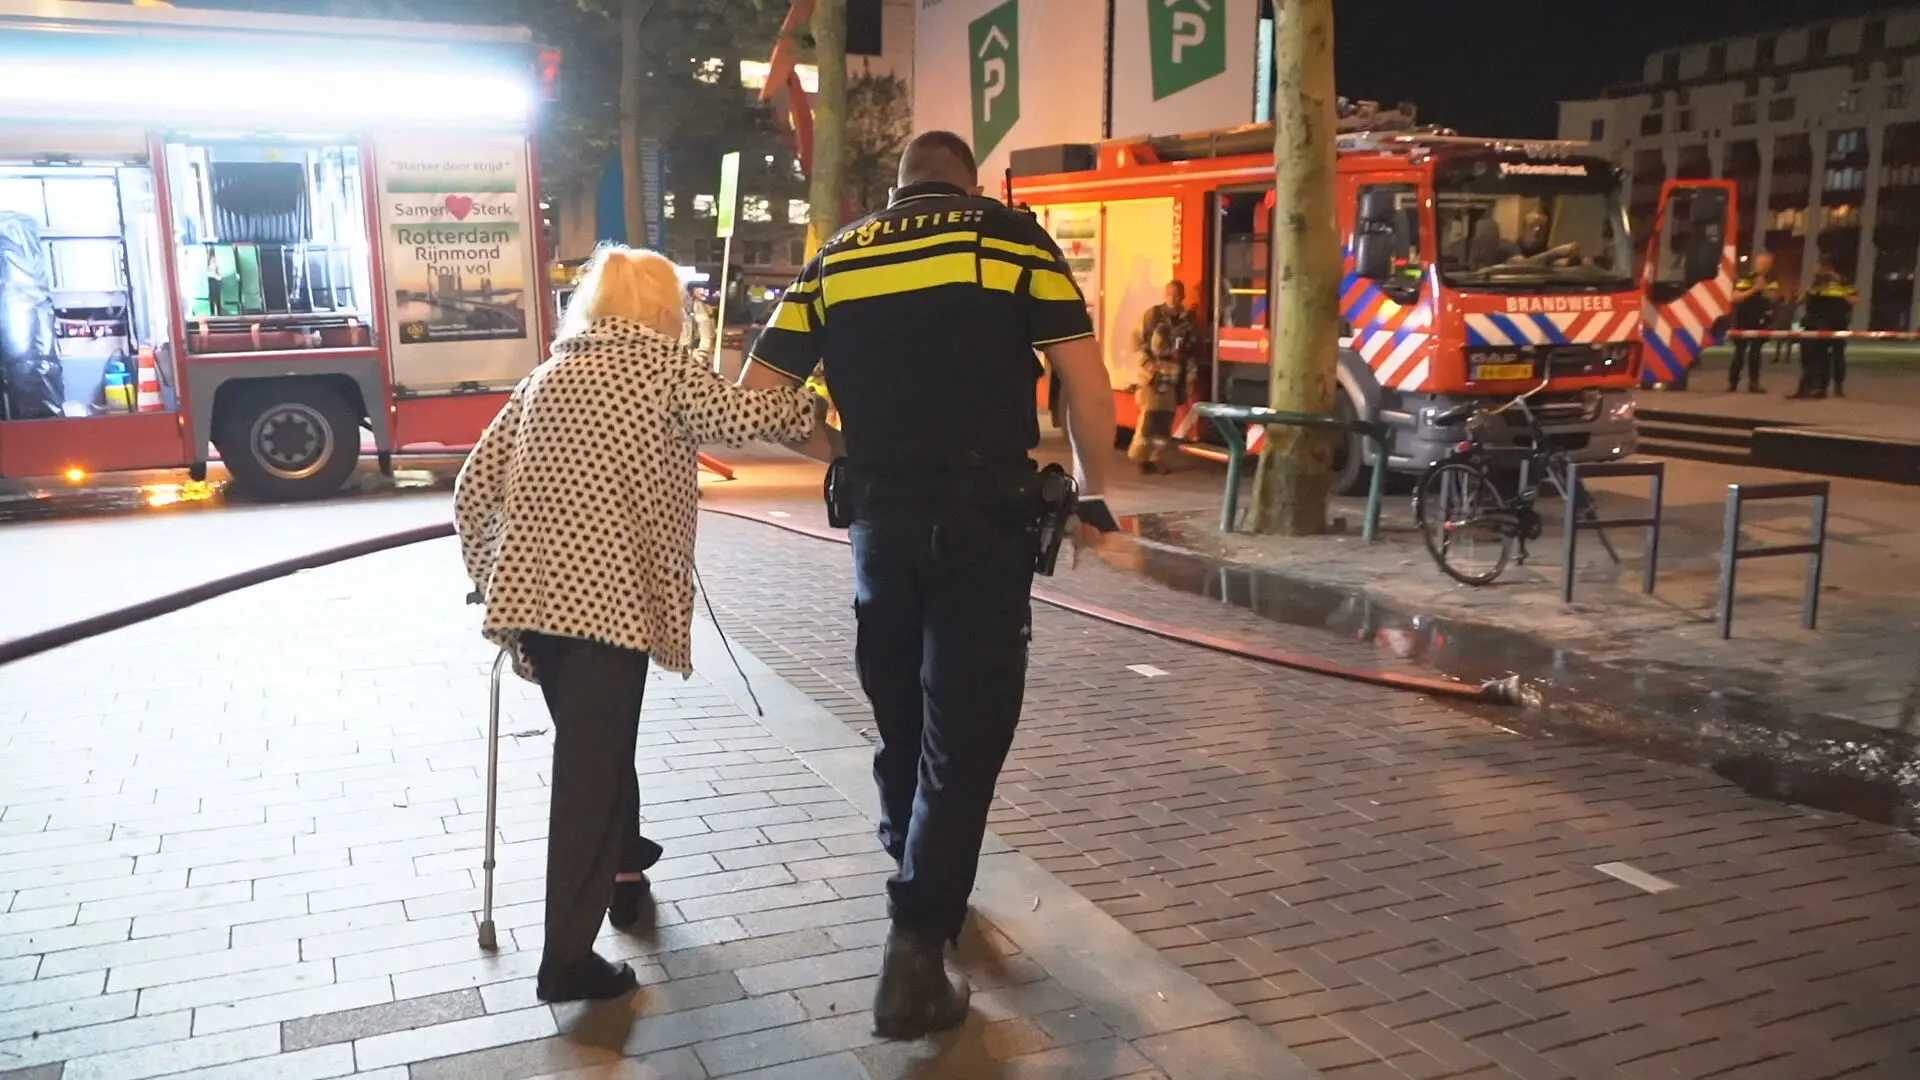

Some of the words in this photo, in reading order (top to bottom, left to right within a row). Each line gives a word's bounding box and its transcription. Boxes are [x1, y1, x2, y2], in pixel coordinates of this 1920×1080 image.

[394, 203, 449, 217] Samen
[472, 200, 513, 216] Sterk
[398, 227, 510, 246] Rotterdam
[842, 211, 962, 246] POLITIE
[415, 246, 501, 264] Rijnmond
[466, 261, 492, 276] vol
[1506, 296, 1613, 312] BRANDWEER
